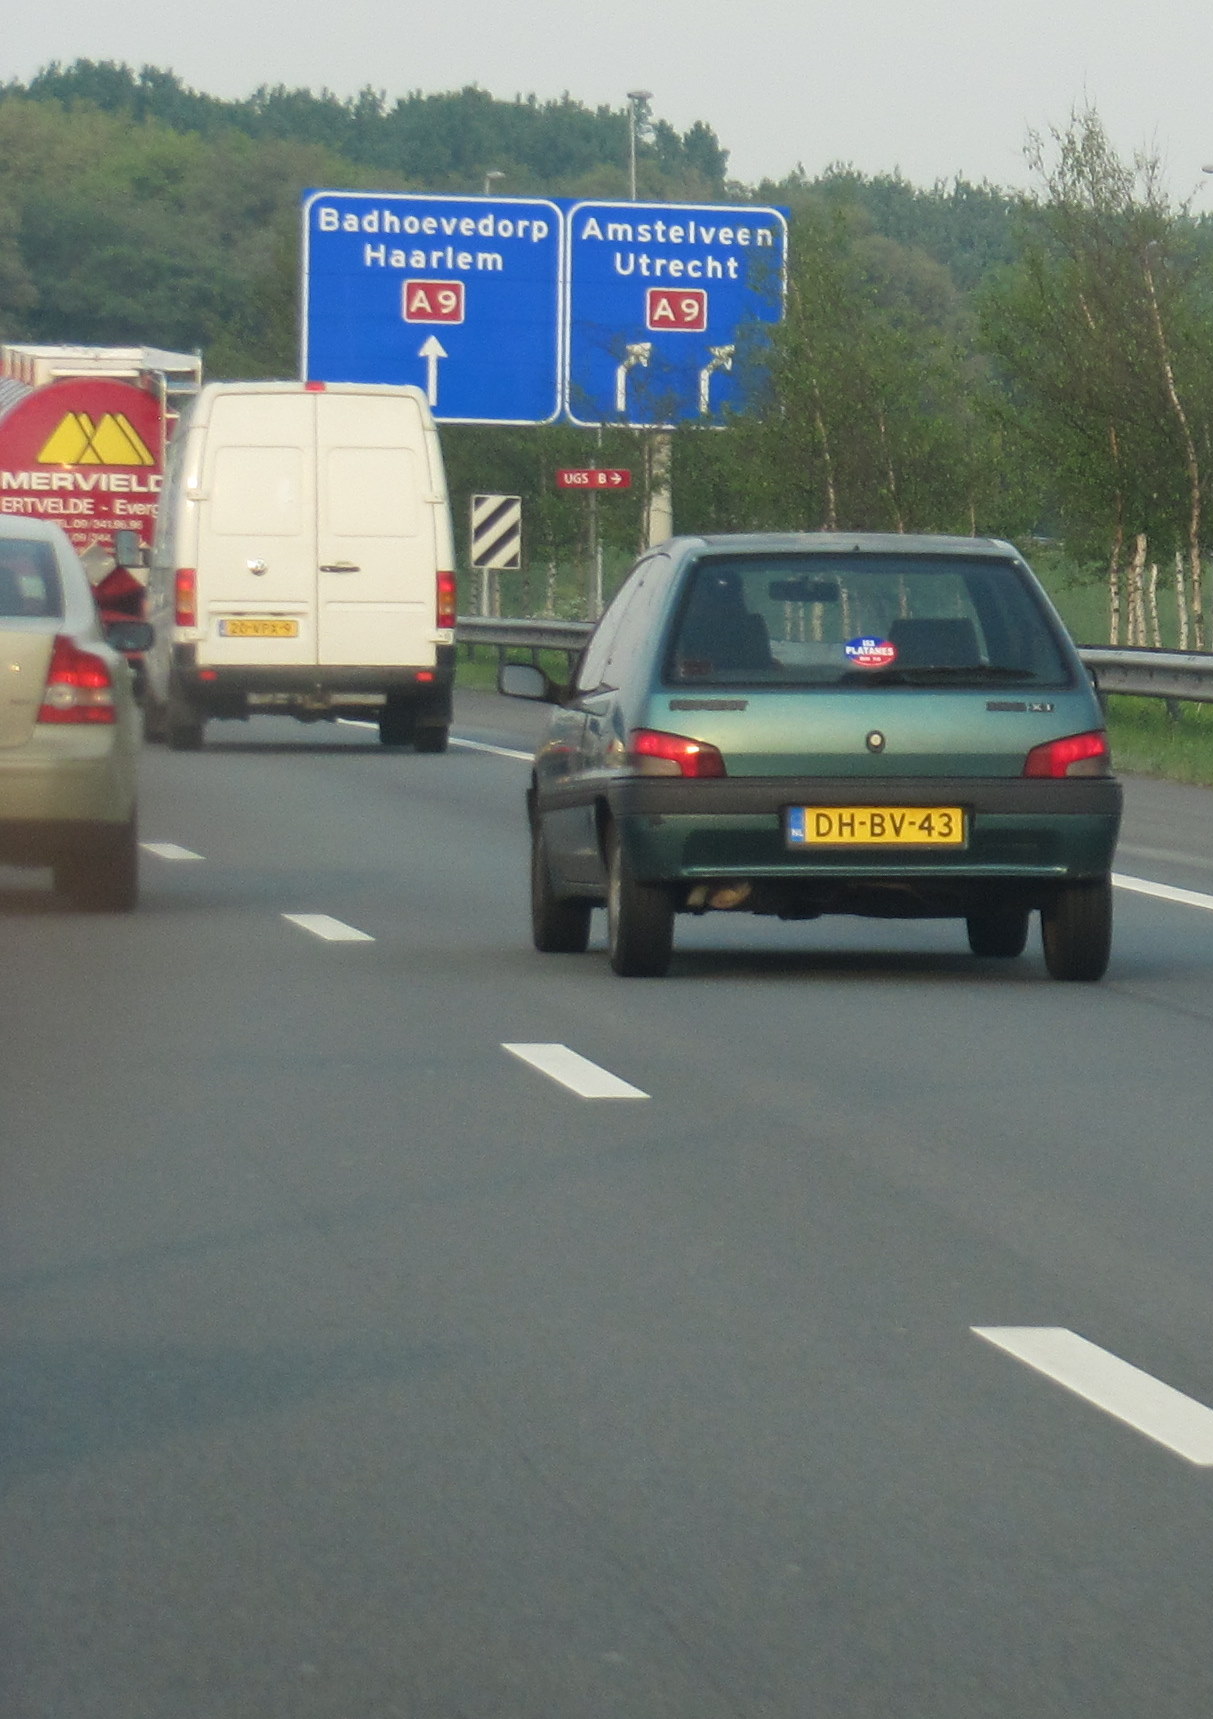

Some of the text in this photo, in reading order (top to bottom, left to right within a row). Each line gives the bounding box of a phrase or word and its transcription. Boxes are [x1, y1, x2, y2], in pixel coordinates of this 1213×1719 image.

[318, 207, 550, 243] Badhoevedorp
[582, 217, 774, 248] Amstelveen
[364, 243, 504, 272] Haarlem
[615, 252, 740, 280] Utrecht
[564, 472, 607, 485] UGS B
[815, 812, 953, 838] DH-BV-43
